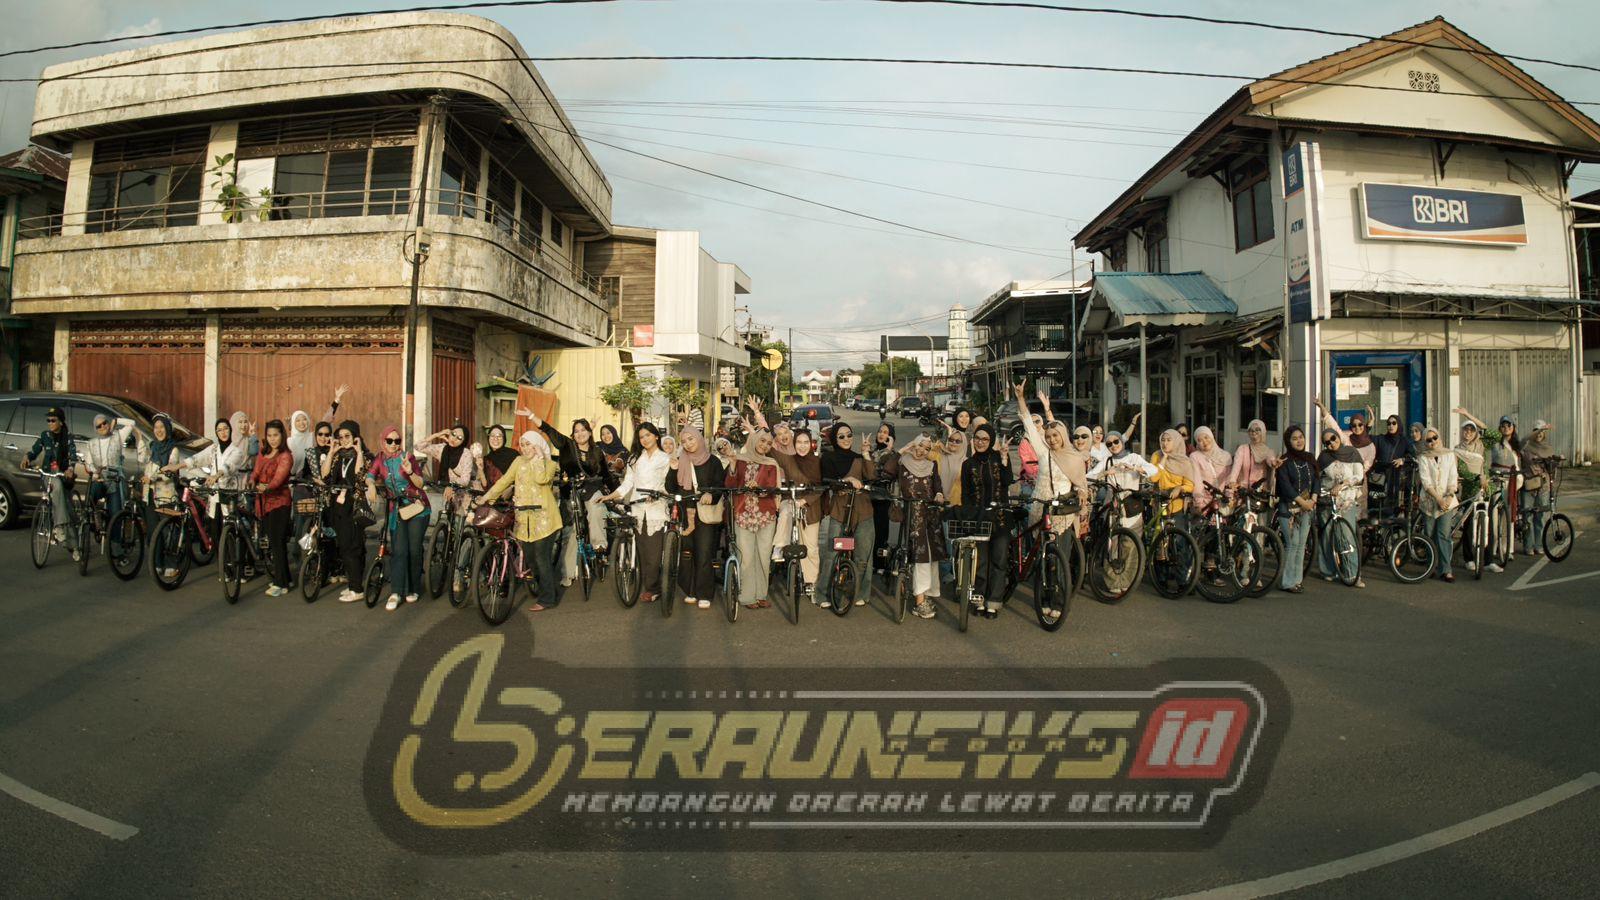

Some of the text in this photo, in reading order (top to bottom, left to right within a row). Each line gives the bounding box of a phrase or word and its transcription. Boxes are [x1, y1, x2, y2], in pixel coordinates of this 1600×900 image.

[1289, 172, 1298, 188] BRI
[1434, 198, 1469, 224] BRI
[1290, 218, 1304, 235] ATM
